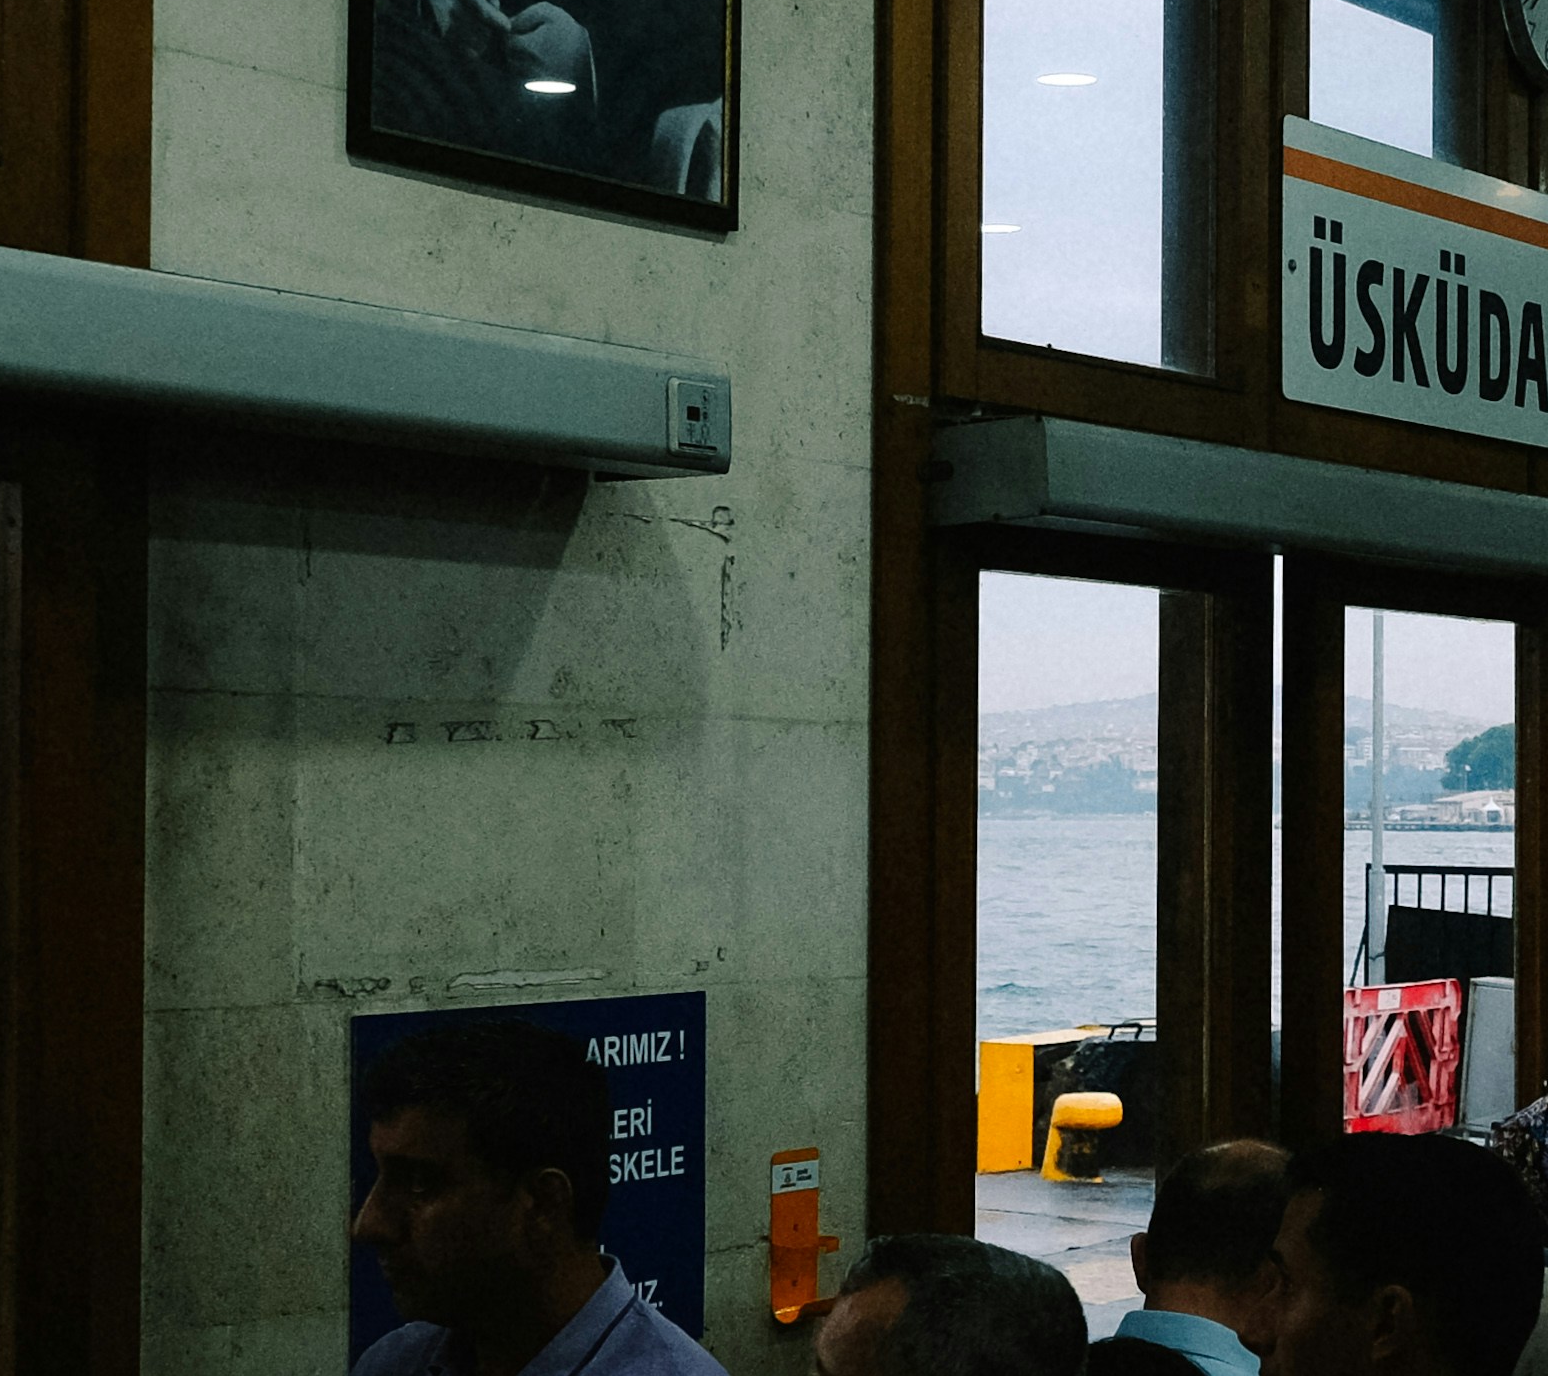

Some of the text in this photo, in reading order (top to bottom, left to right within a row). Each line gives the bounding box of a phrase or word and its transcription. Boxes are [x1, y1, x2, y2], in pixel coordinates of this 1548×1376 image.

[585, 1030, 672, 1068] ARIMIZ
[612, 1097, 652, 1141] ERİ
[608, 1144, 685, 1185] SKELE
